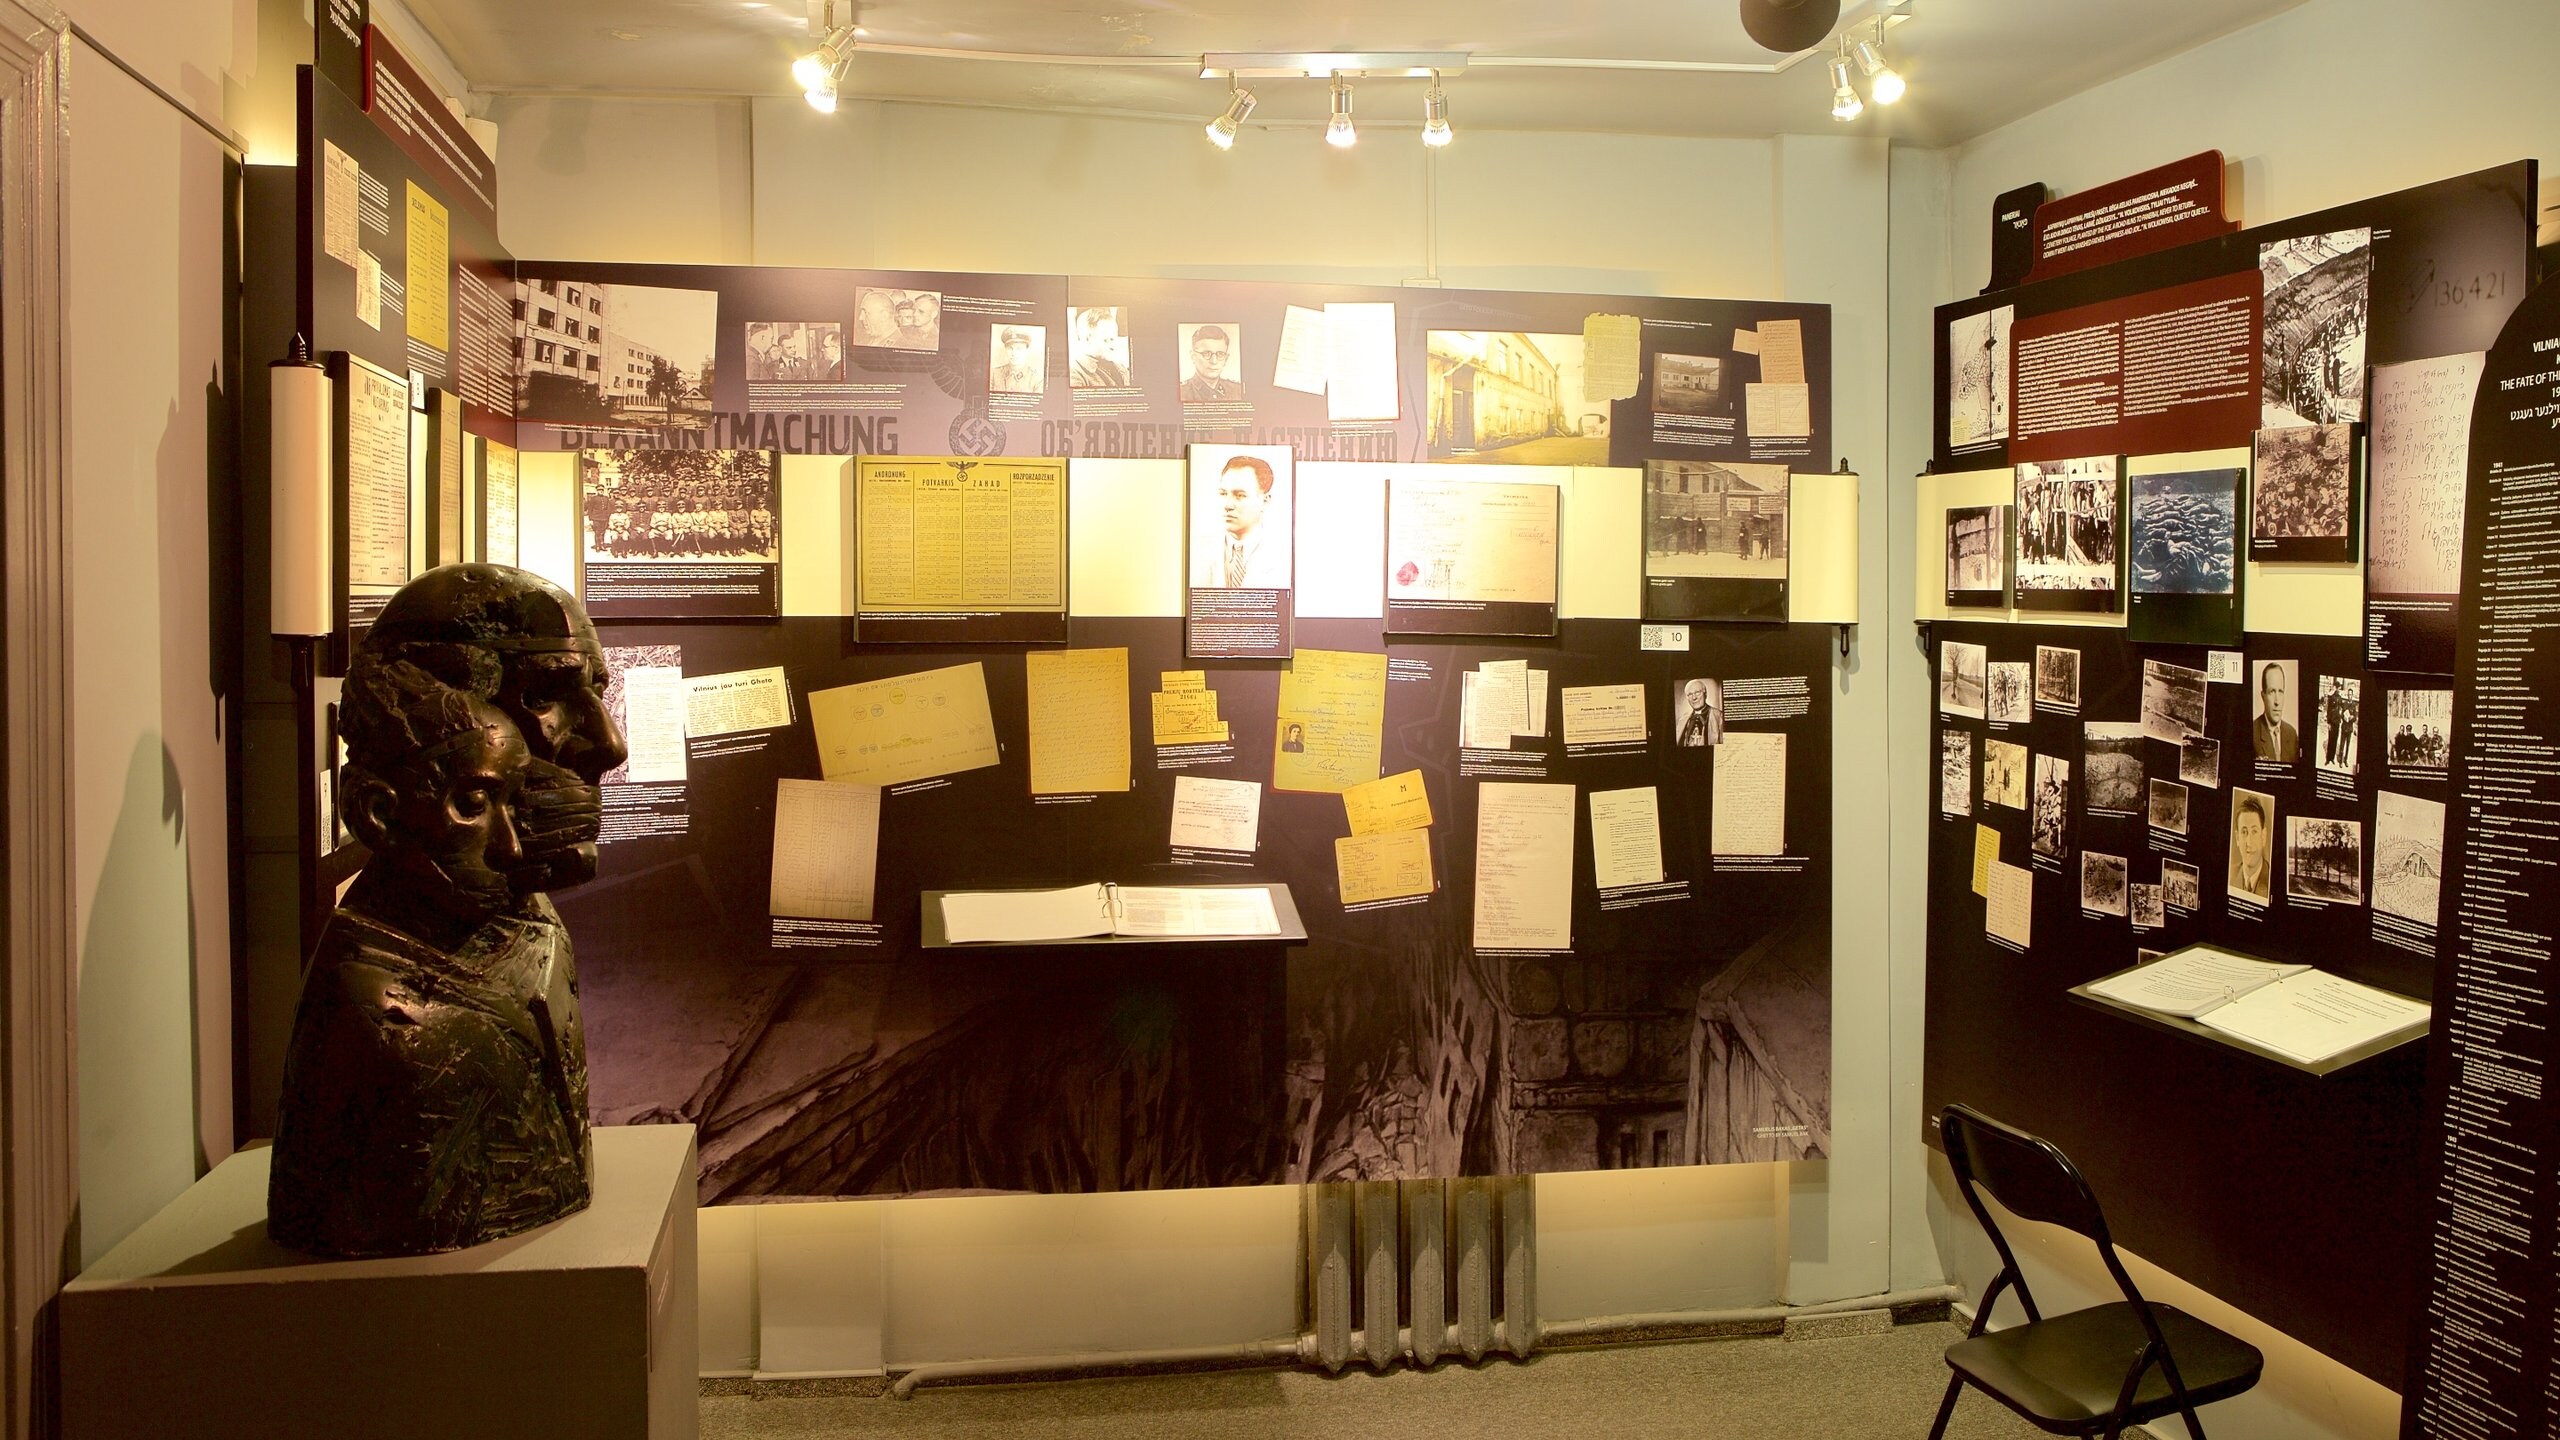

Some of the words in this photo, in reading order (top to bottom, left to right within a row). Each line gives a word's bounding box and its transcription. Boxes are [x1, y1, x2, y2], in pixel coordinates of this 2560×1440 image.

[2533, 337, 2560, 353] VILNIA
[2500, 378, 2515, 391] THE
[2516, 375, 2535, 388] FATE
[2535, 372, 2547, 385] OF
[874, 470, 906, 479] ANORDNUNG
[922, 479, 955, 487] POTVARKIS
[1671, 632, 1683, 643] 10
[2232, 661, 2238, 673] 11
[693, 684, 717, 692] Vilnius
[720, 682, 732, 690] jau
[751, 677, 772, 685] Gheto
